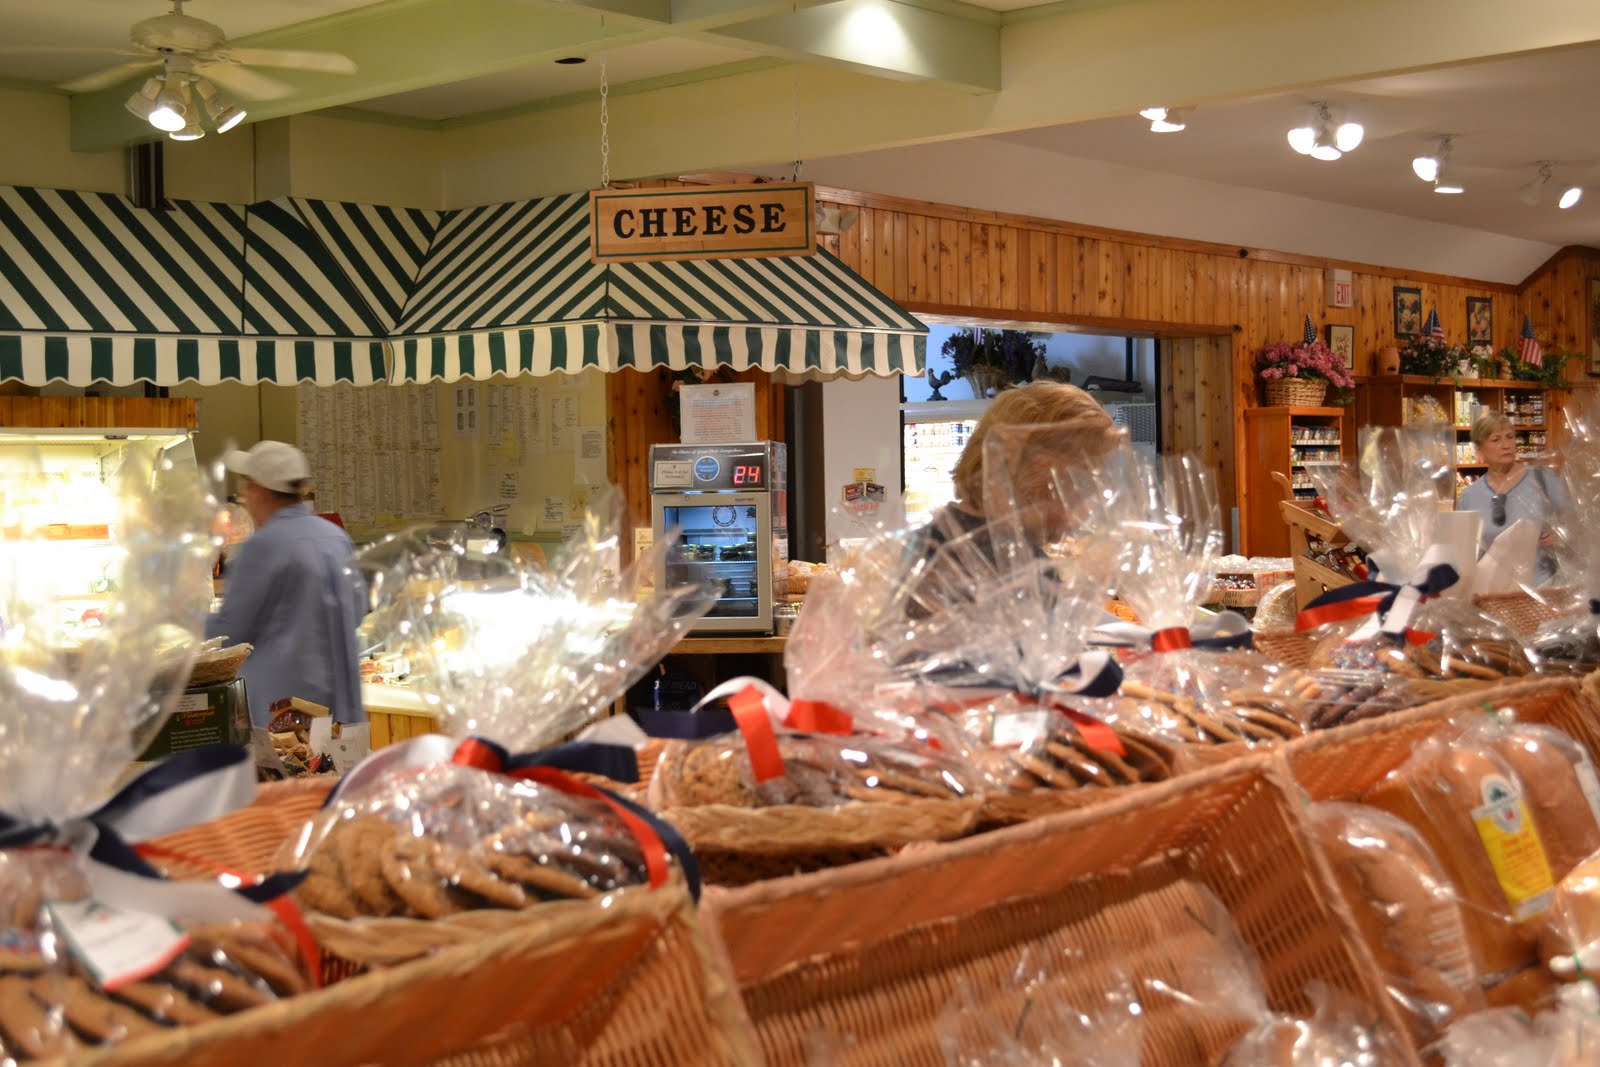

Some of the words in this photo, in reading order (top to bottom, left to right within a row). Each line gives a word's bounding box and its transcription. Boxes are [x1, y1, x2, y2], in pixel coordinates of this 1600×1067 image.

[613, 203, 787, 239] CHEESE
[1336, 282, 1351, 305] EXIT
[734, 465, 760, 484] 24
